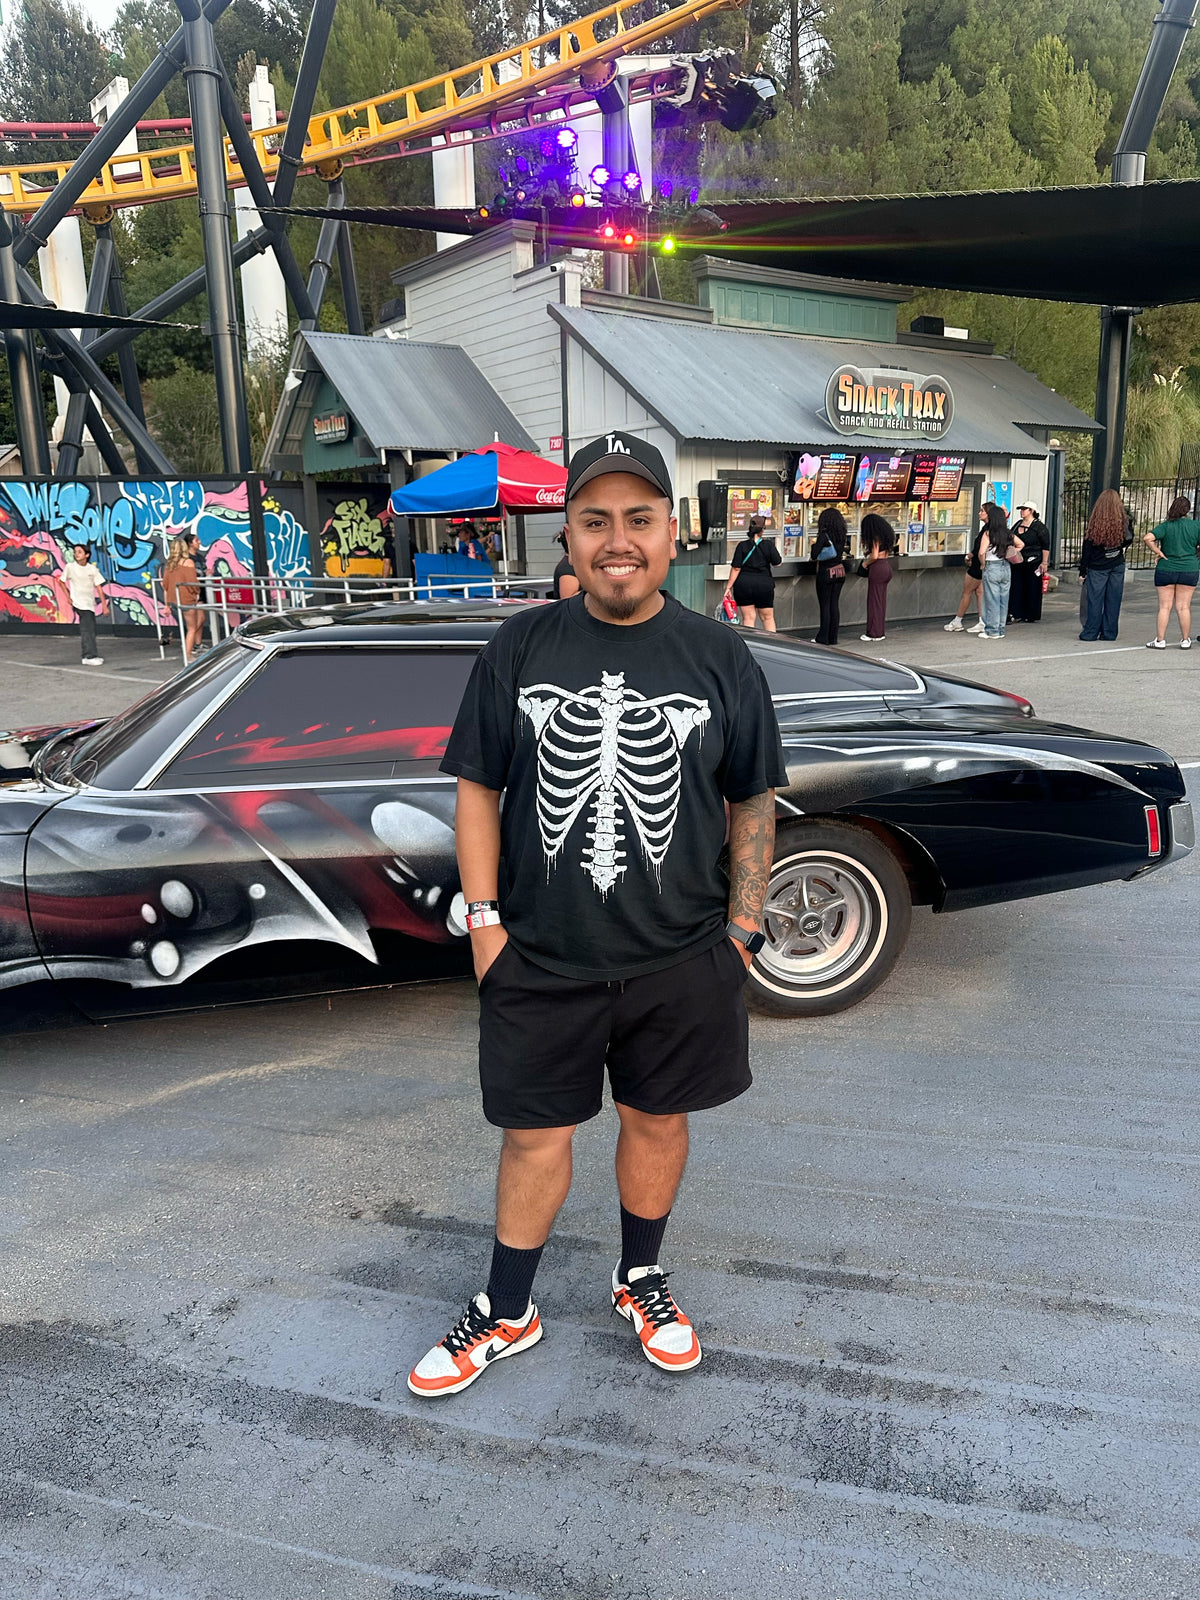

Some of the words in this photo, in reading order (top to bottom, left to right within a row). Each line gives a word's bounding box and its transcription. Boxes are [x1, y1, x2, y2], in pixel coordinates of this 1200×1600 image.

[838, 374, 898, 416] SNACK
[901, 382, 946, 420] TRAX
[840, 415, 866, 426] SNACK
[869, 417, 884, 428] AND
[887, 418, 910, 430] REFILL
[913, 420, 942, 432] STATION
[605, 434, 631, 455] LA
[536, 488, 566, 504] Coca-Co
[335, 498, 371, 523] SIX
[938, 512, 945, 524] A
